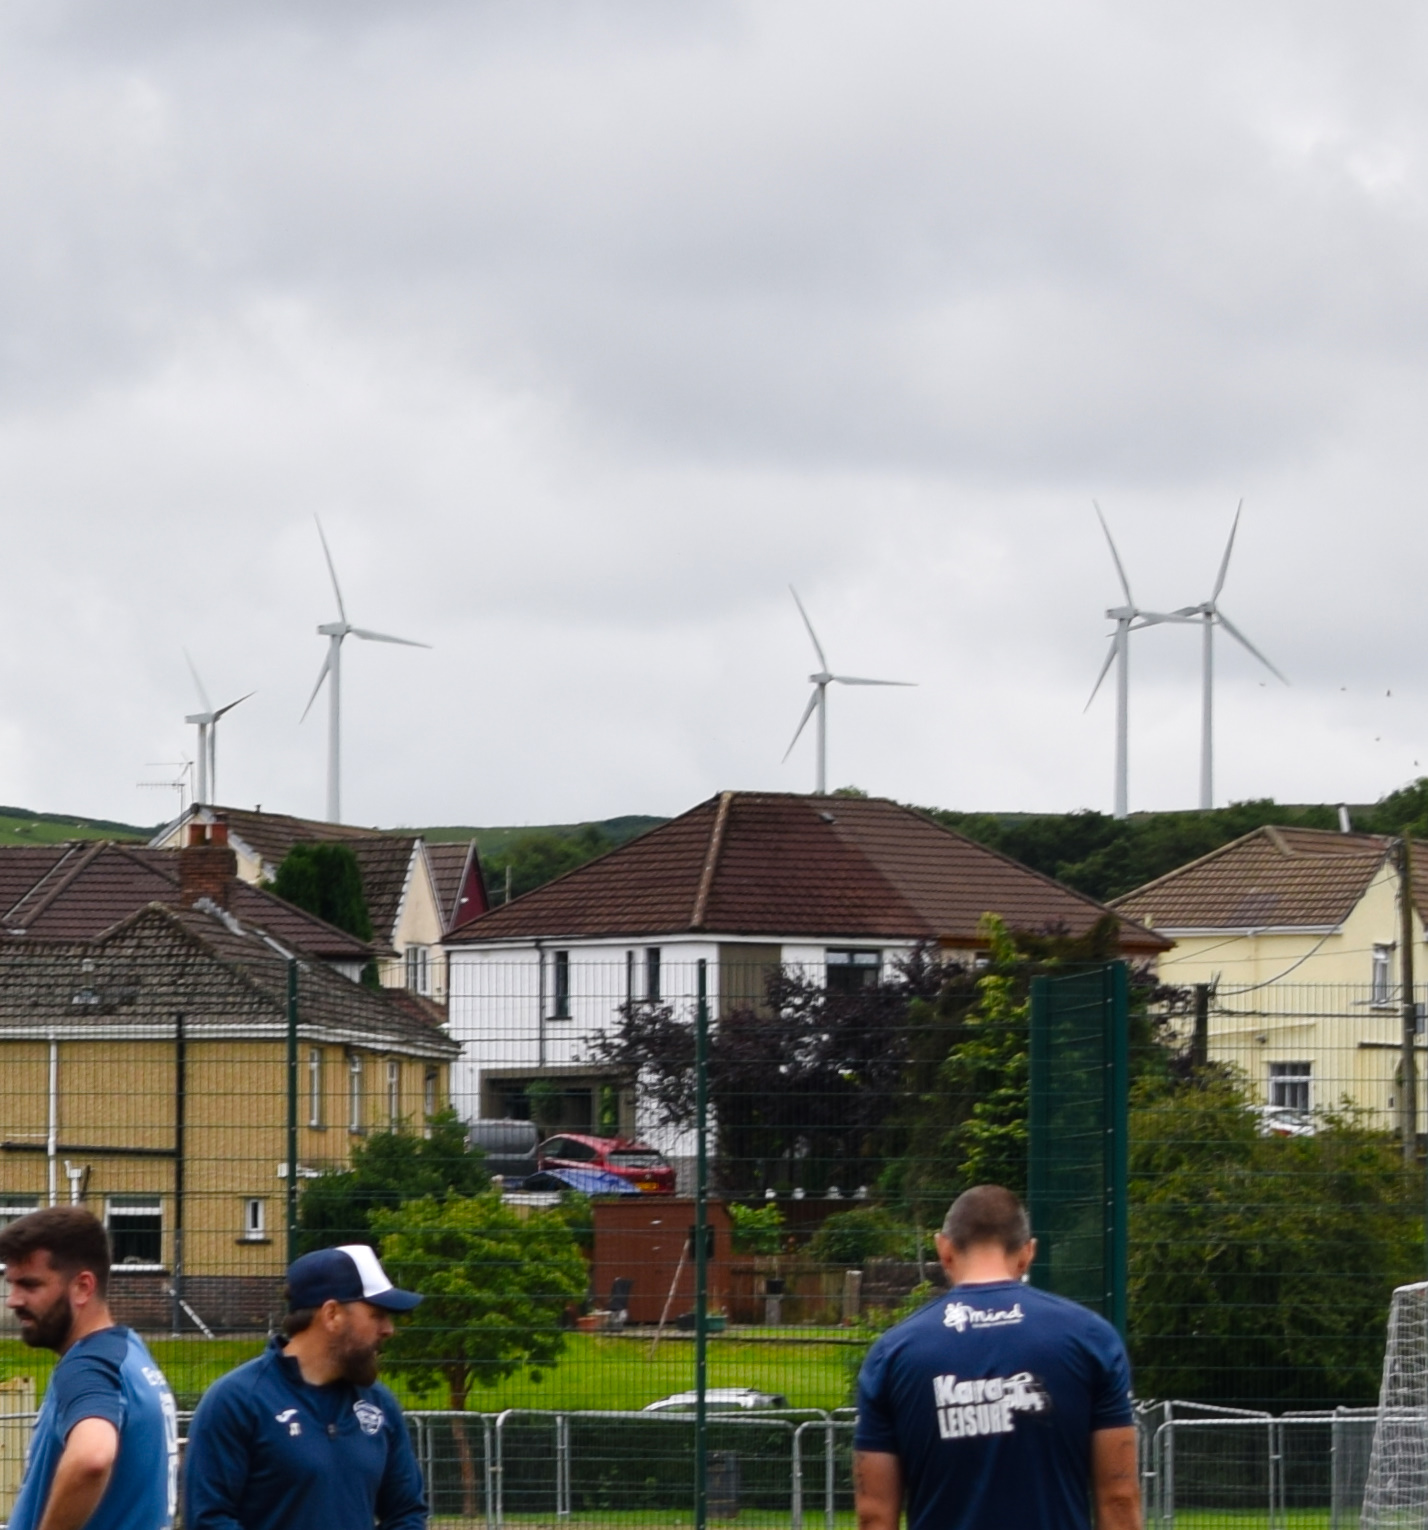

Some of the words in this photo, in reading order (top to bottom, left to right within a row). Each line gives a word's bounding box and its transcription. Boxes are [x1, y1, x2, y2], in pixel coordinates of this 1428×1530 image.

[970, 1303, 1024, 1322] mind
[933, 1375, 1003, 1407] Kara
[937, 1402, 1014, 1439] LEISURE
